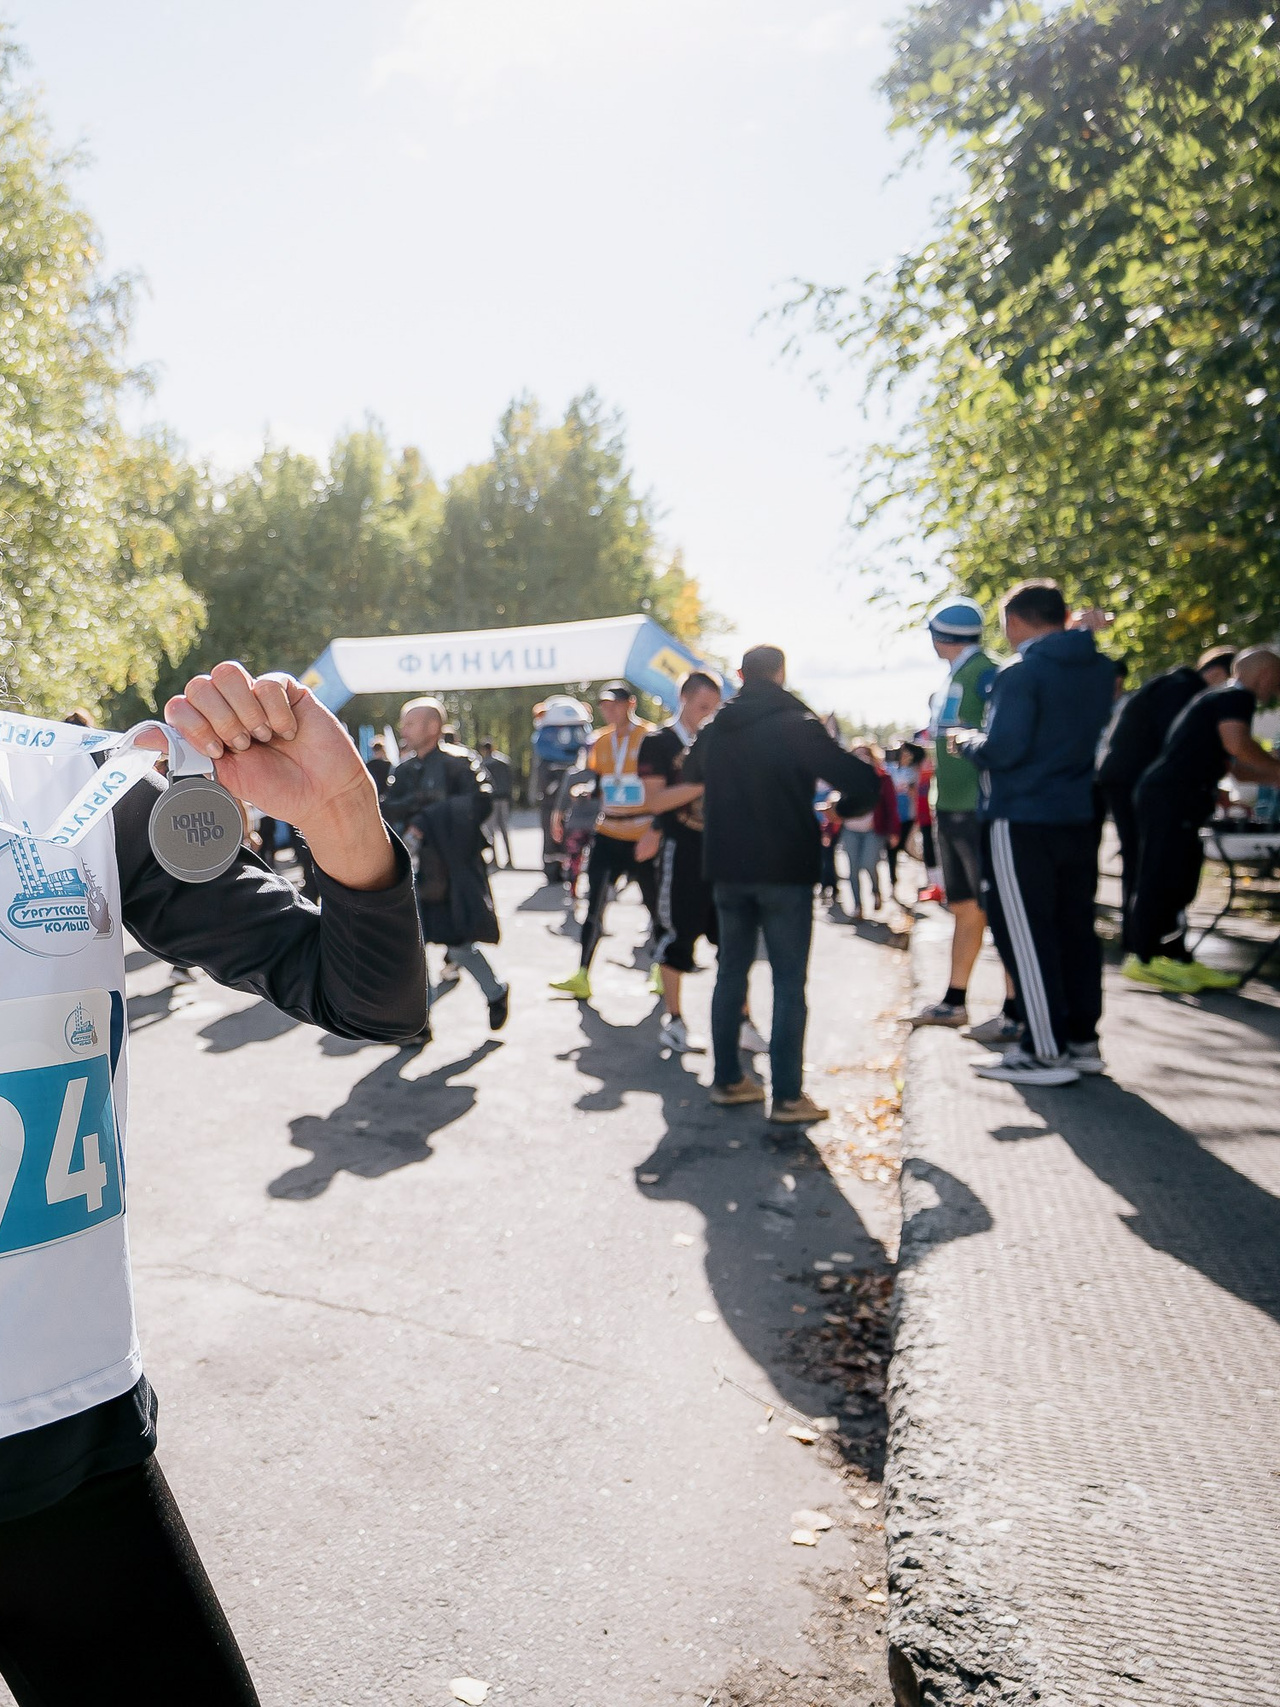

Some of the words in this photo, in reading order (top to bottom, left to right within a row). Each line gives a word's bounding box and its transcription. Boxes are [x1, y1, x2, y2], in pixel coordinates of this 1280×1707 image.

[398, 645, 556, 676] ФИНИШ
[52, 770, 128, 845] СУРГУТС
[44, 920, 90, 934] КОЛЬЦО
